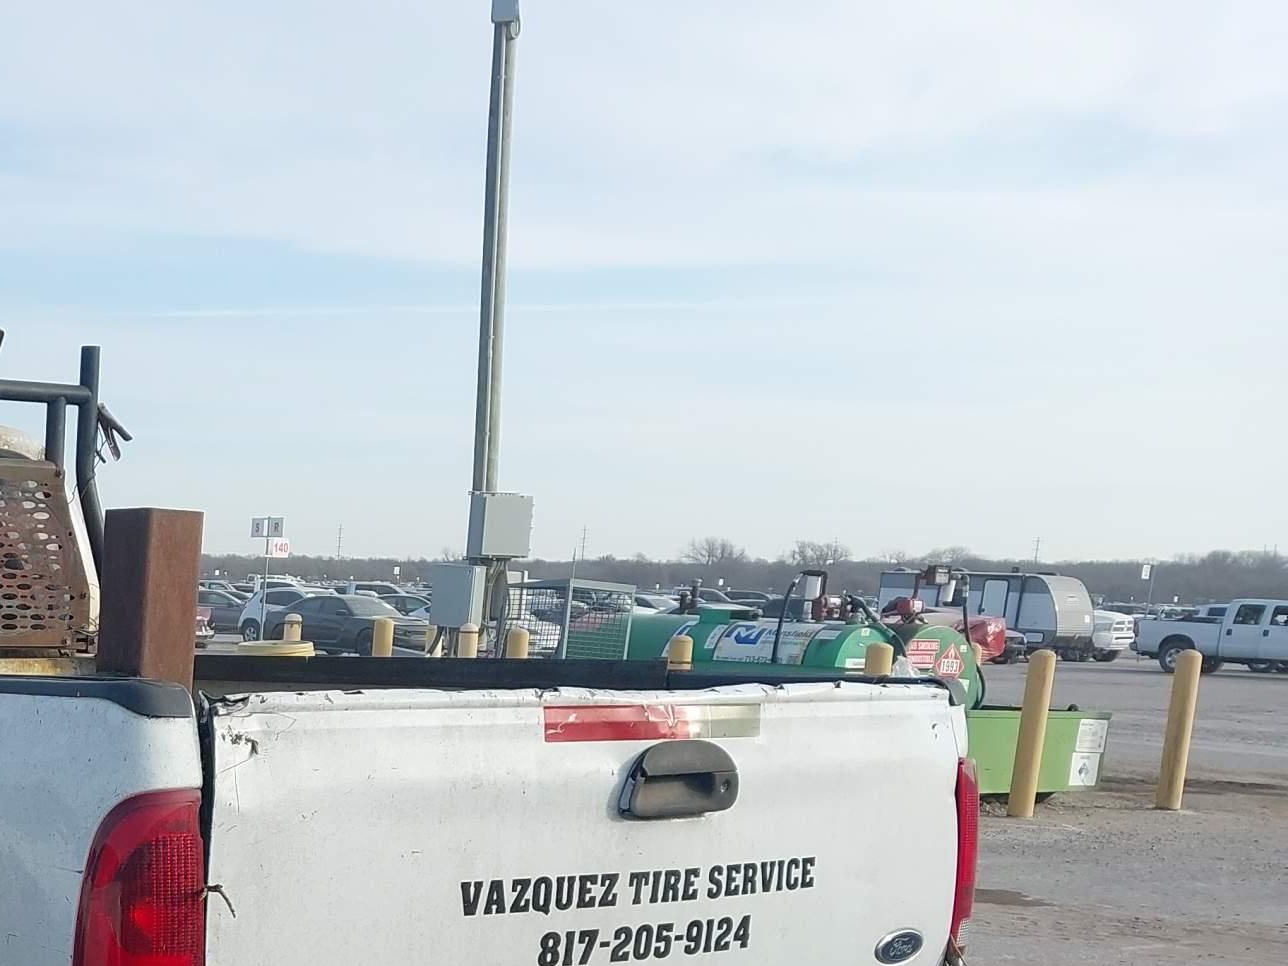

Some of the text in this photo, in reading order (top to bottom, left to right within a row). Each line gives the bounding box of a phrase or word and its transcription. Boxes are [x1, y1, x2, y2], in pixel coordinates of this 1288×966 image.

[274, 522, 280, 533] R
[274, 542, 289, 553] 140
[942, 660, 959, 673] 1993
[460, 856, 816, 917] VAZQUEZ TIRE SERVICE
